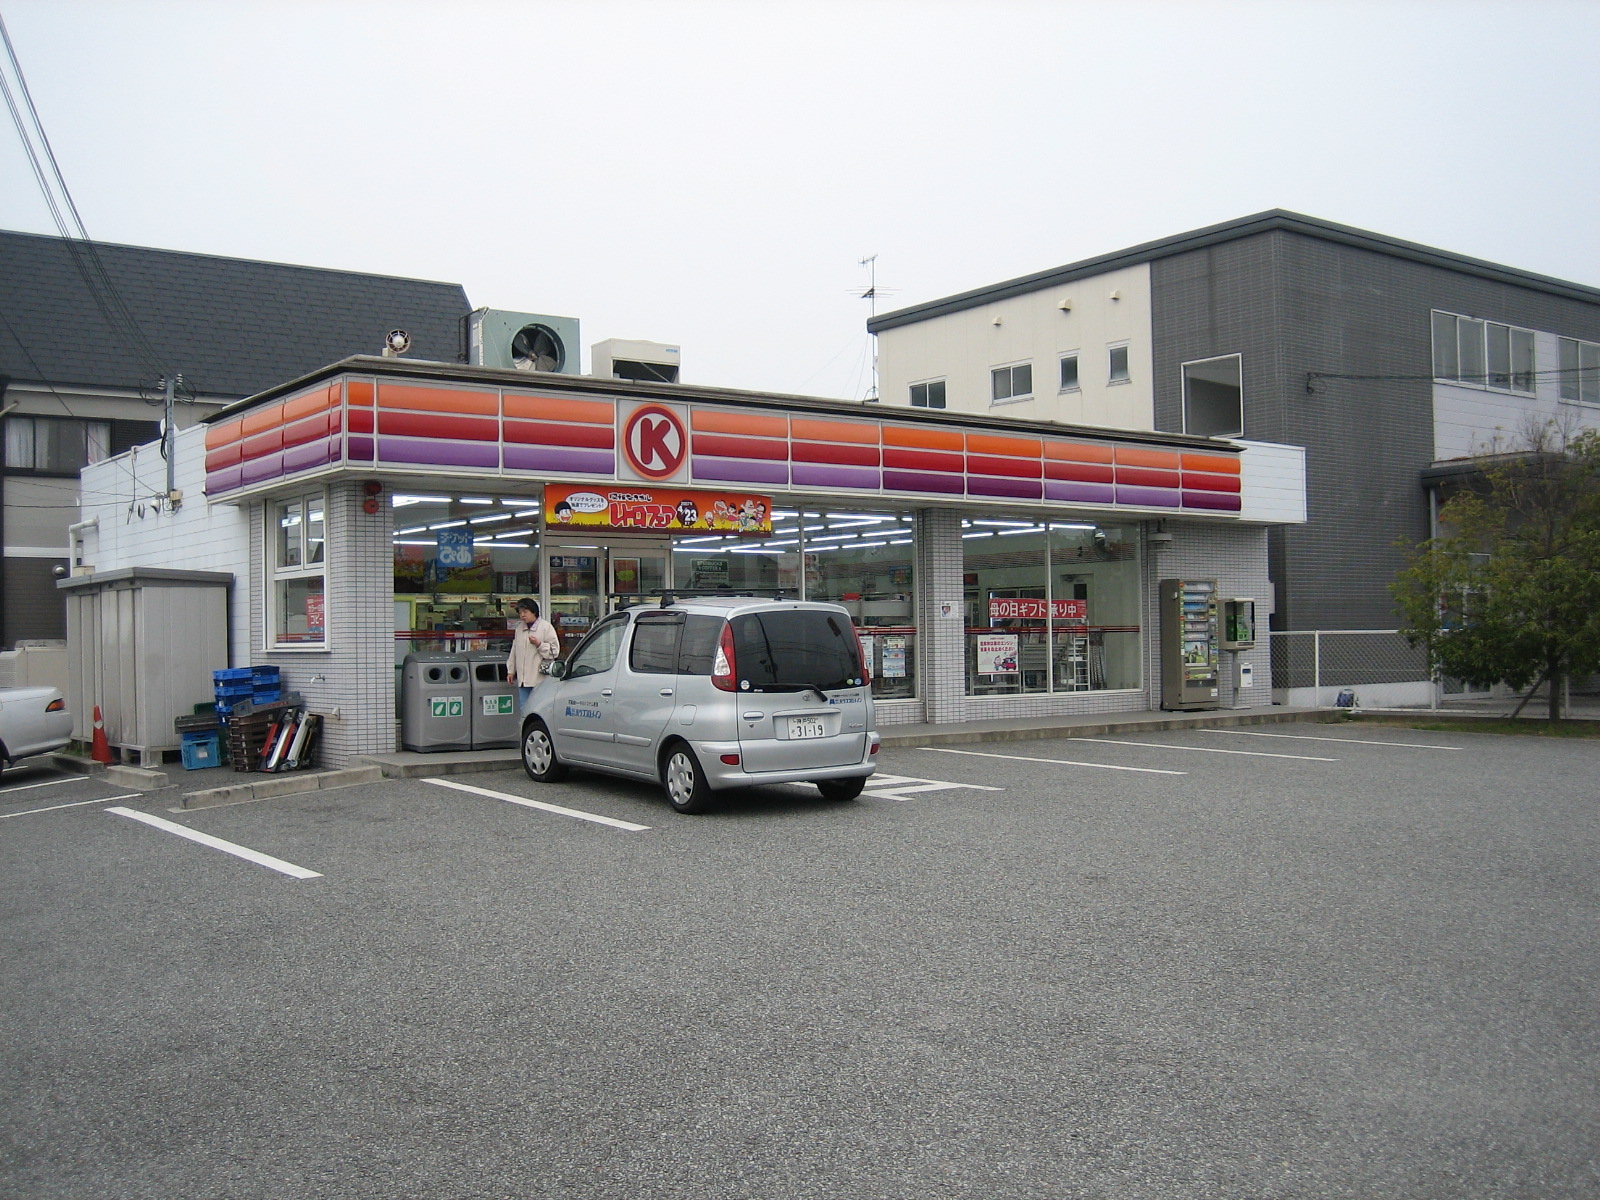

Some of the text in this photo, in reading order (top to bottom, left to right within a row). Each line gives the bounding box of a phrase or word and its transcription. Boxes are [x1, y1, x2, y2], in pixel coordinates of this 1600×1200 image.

[640, 417, 678, 469] K
[440, 532, 473, 544] チケット
[440, 545, 472, 564] ぴあ
[989, 602, 1077, 617] 母の日ギフト承り中
[796, 724, 824, 738] 31-19
